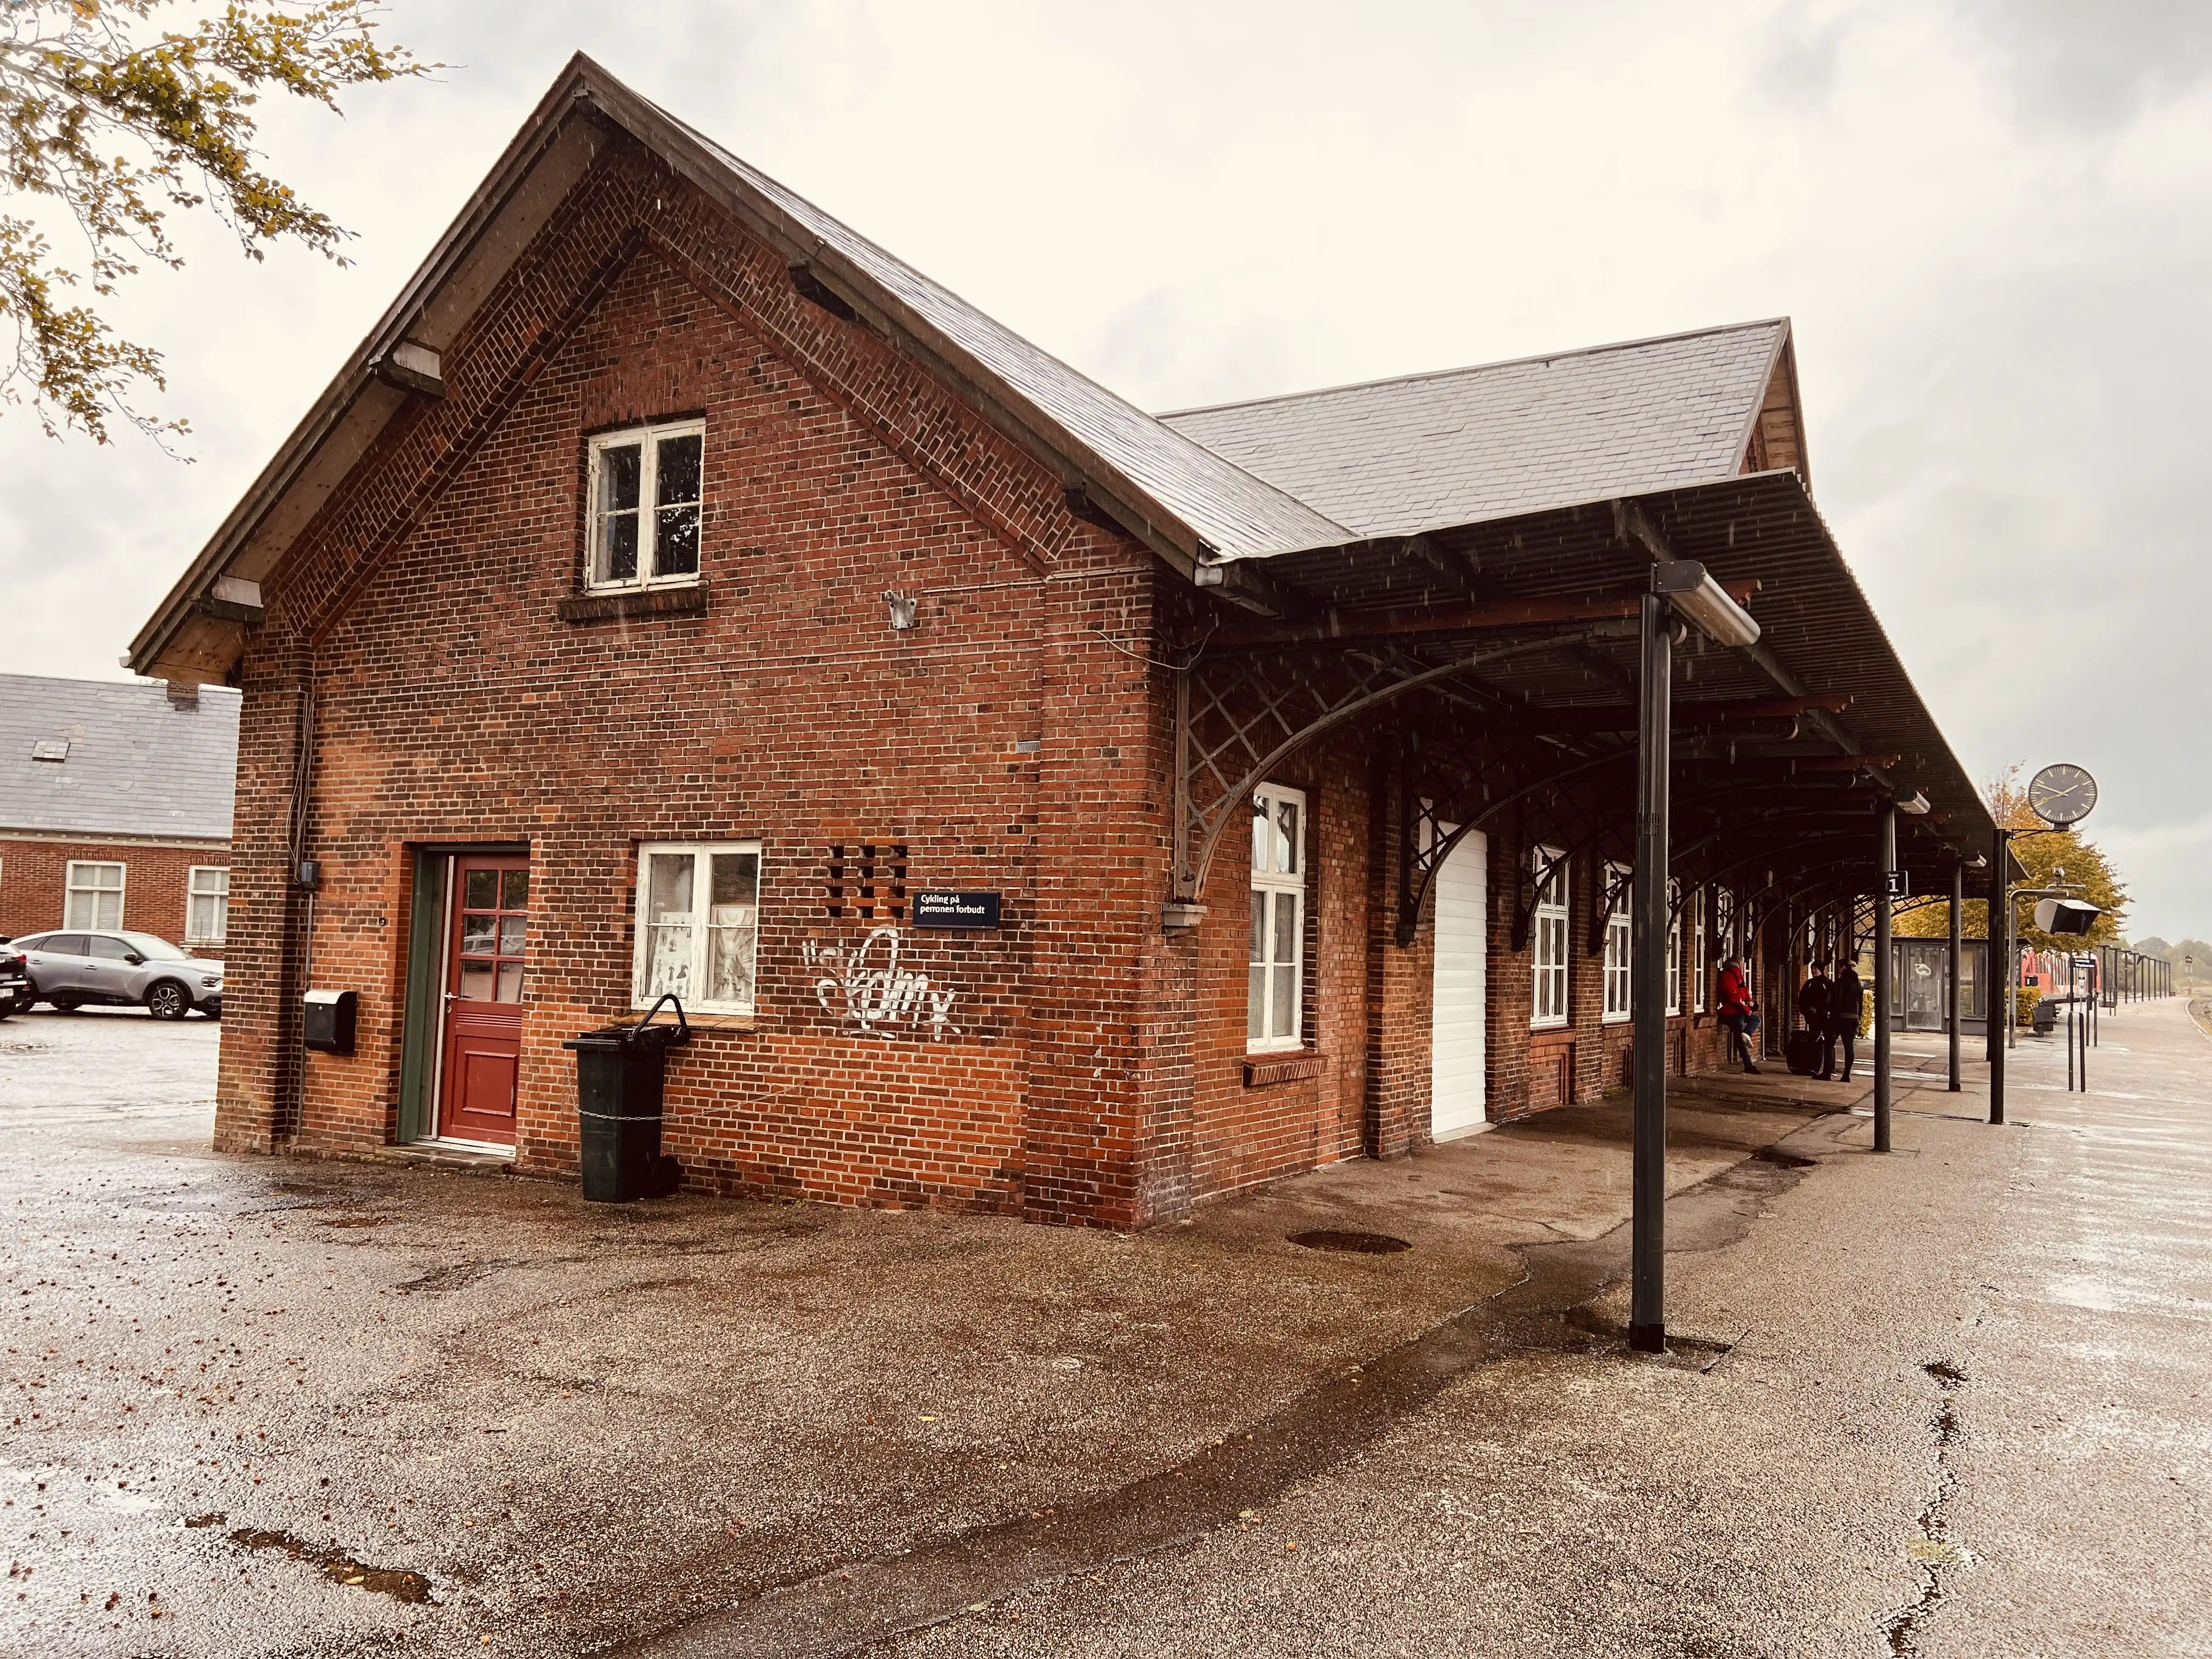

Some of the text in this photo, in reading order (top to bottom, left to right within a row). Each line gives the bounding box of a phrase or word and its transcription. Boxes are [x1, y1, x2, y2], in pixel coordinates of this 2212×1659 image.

[1889, 878, 1898, 891] 1
[921, 894, 960, 905] Cykling på
[920, 905, 985, 914] perronen forbudt
